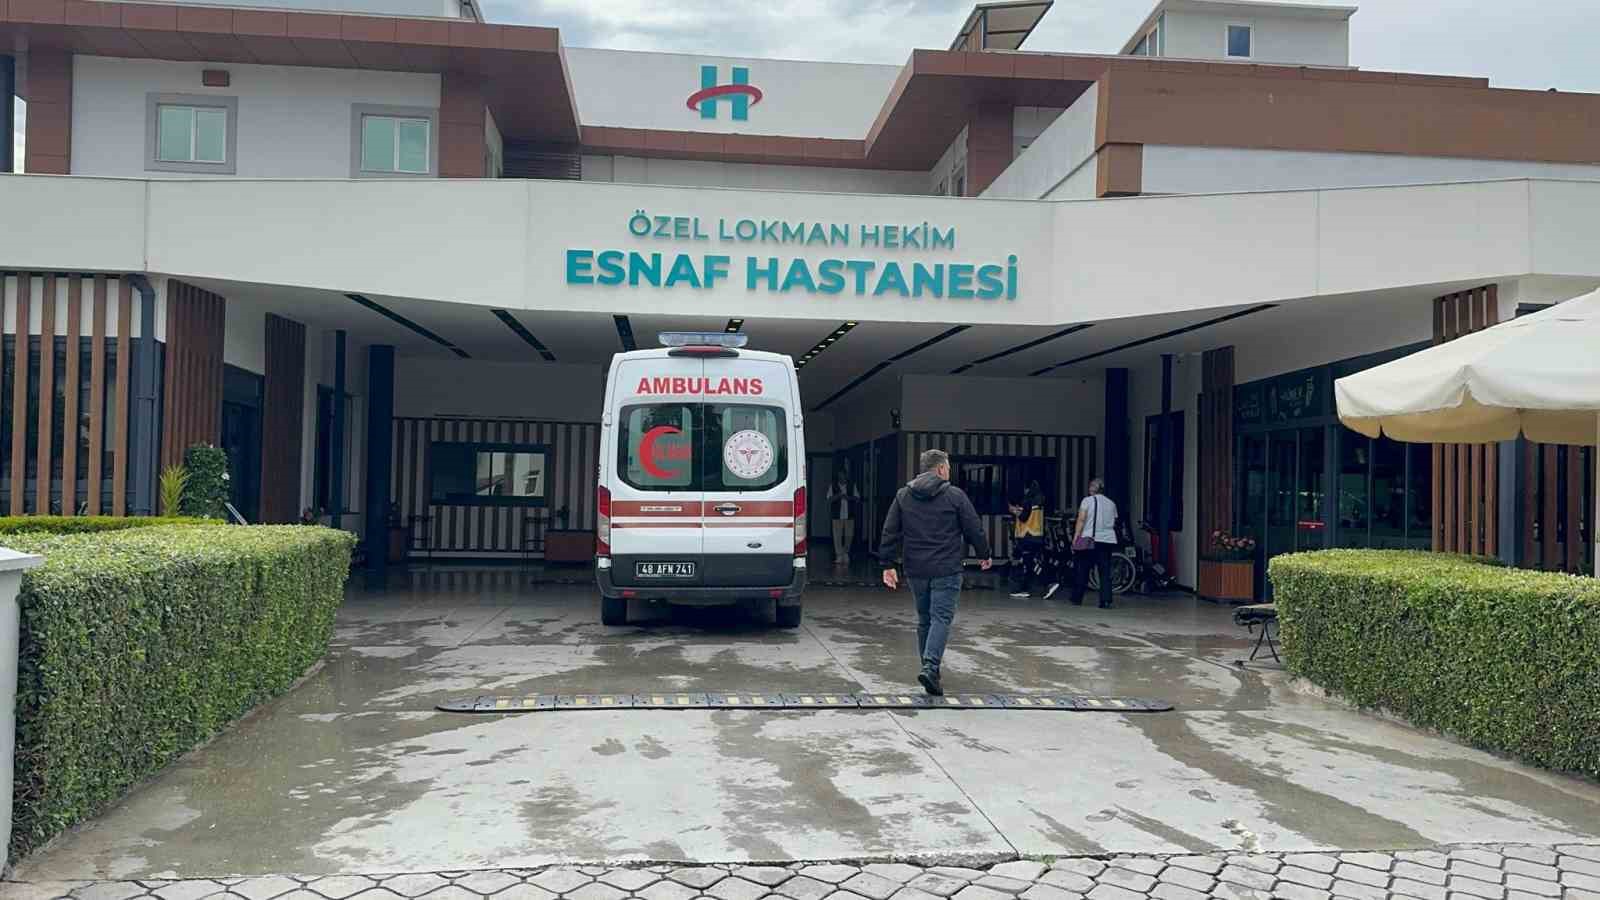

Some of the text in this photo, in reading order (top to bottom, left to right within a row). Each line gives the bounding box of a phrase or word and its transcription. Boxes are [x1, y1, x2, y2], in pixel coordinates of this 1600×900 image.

[628, 209, 955, 250] ÖZEL LOKMAN HEKİM
[566, 249, 1018, 301] ESNAF HASTANESİ
[637, 377, 763, 395] AMBULANS
[641, 564, 654, 574] 48
[675, 564, 692, 574] 741
